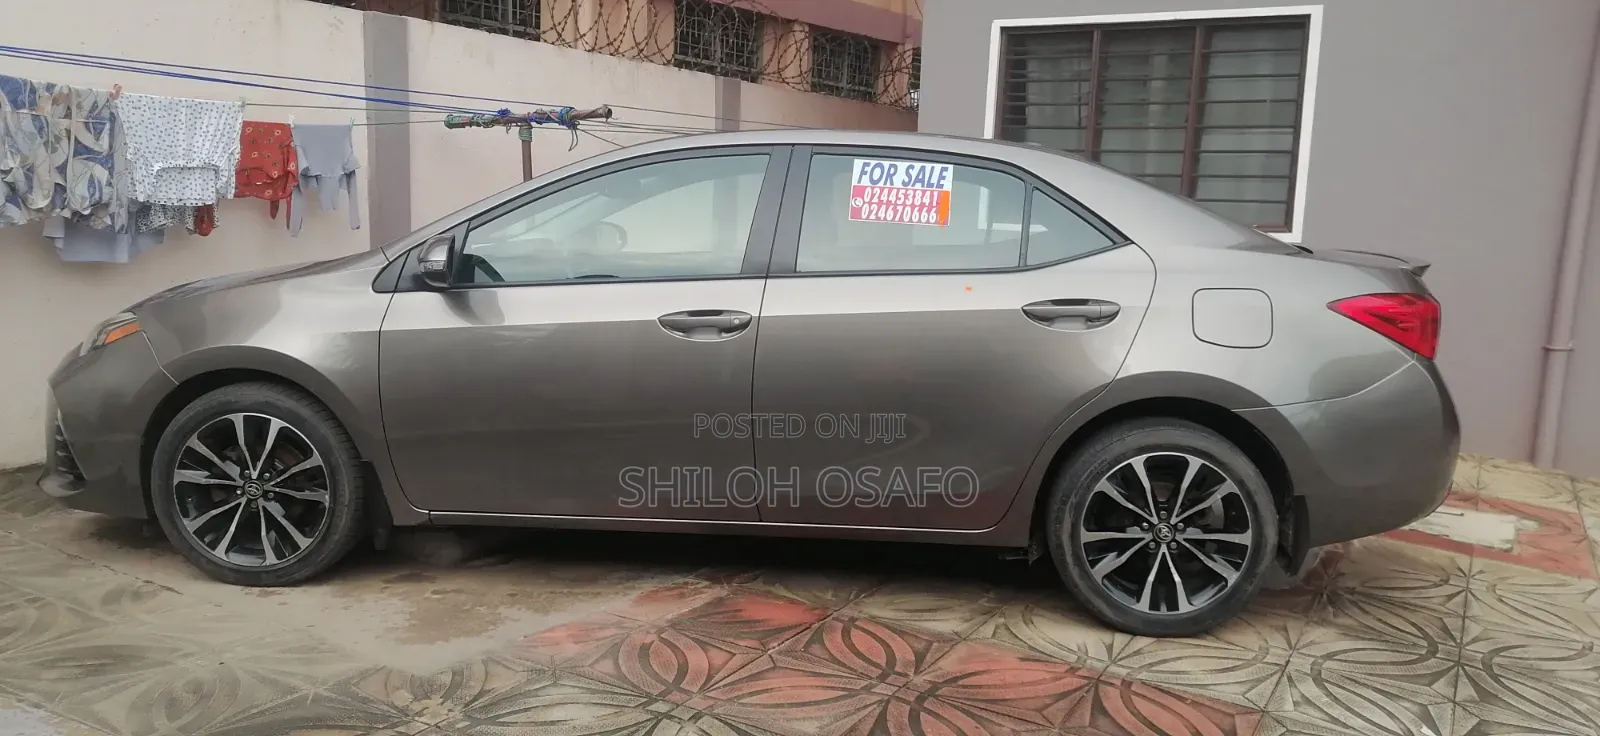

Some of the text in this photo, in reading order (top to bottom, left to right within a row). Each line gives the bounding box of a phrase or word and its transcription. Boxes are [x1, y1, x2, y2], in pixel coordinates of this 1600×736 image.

[857, 162, 949, 189] FOR SALE
[864, 187, 942, 206] 024453841
[861, 204, 943, 223] 024670666
